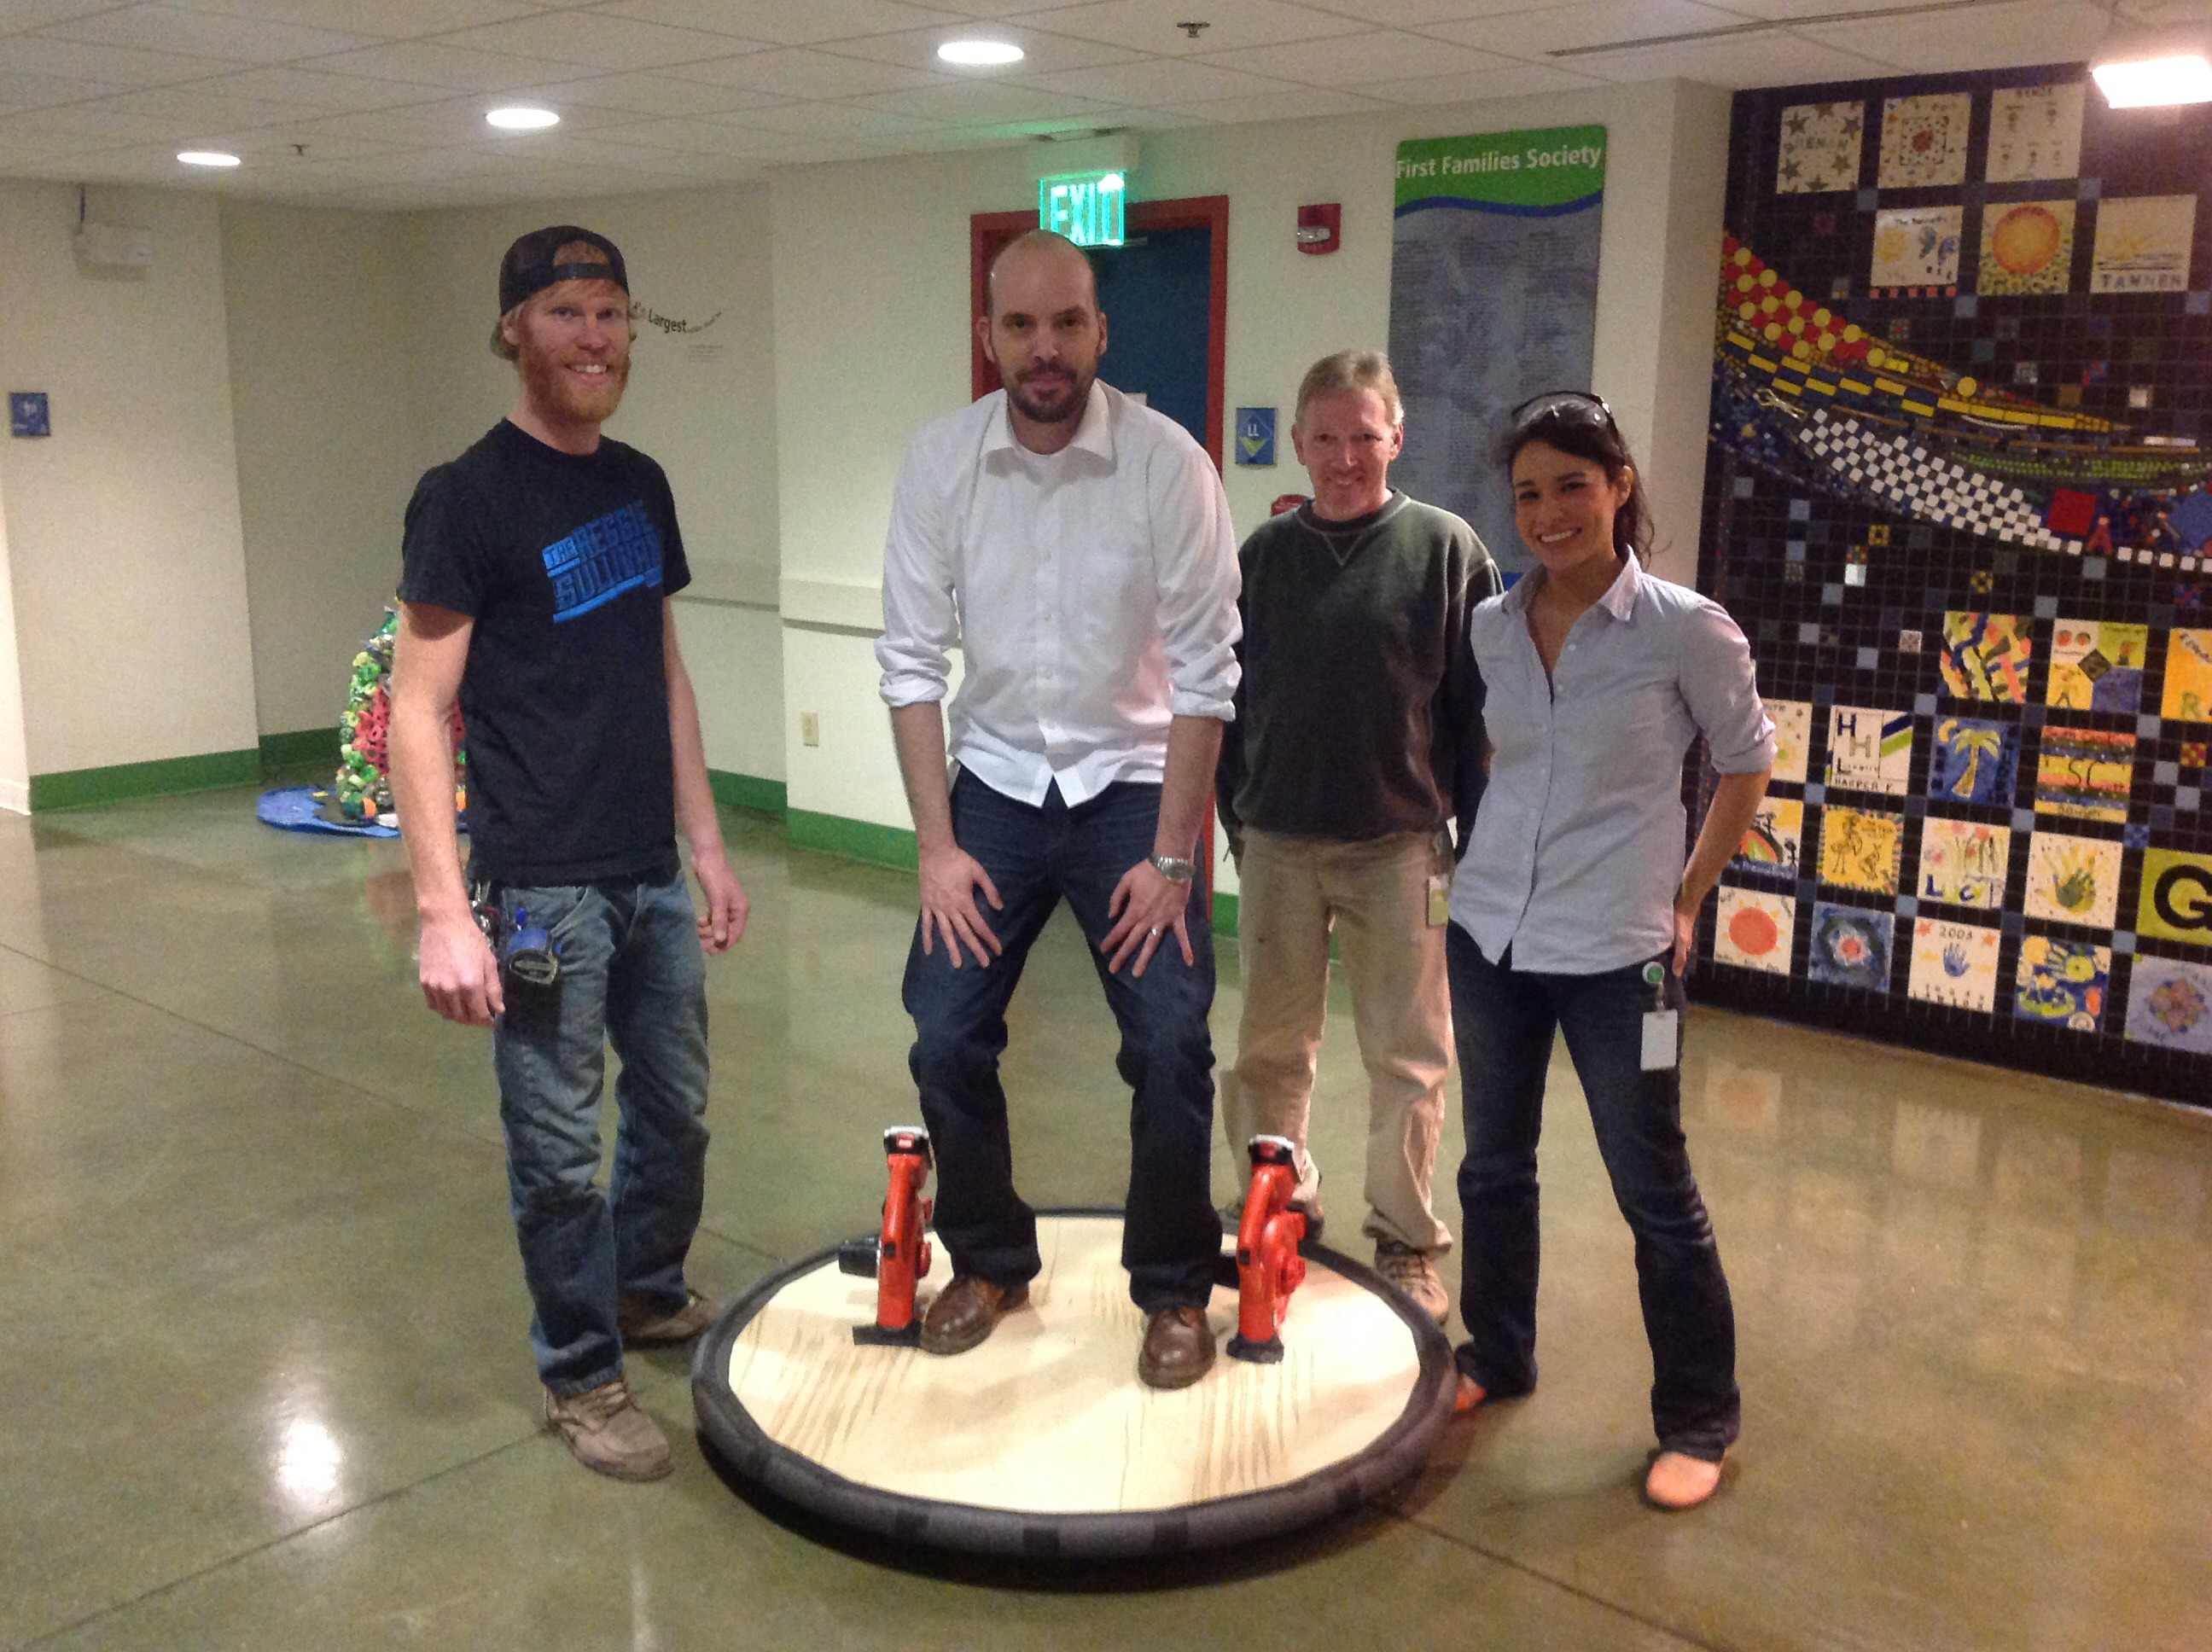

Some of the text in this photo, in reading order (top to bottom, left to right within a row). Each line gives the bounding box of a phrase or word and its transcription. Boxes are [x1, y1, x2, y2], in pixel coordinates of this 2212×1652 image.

[1396, 144, 1601, 178] First Families Society
[1050, 177, 1121, 246] EXIT
[544, 538, 576, 567] THE
